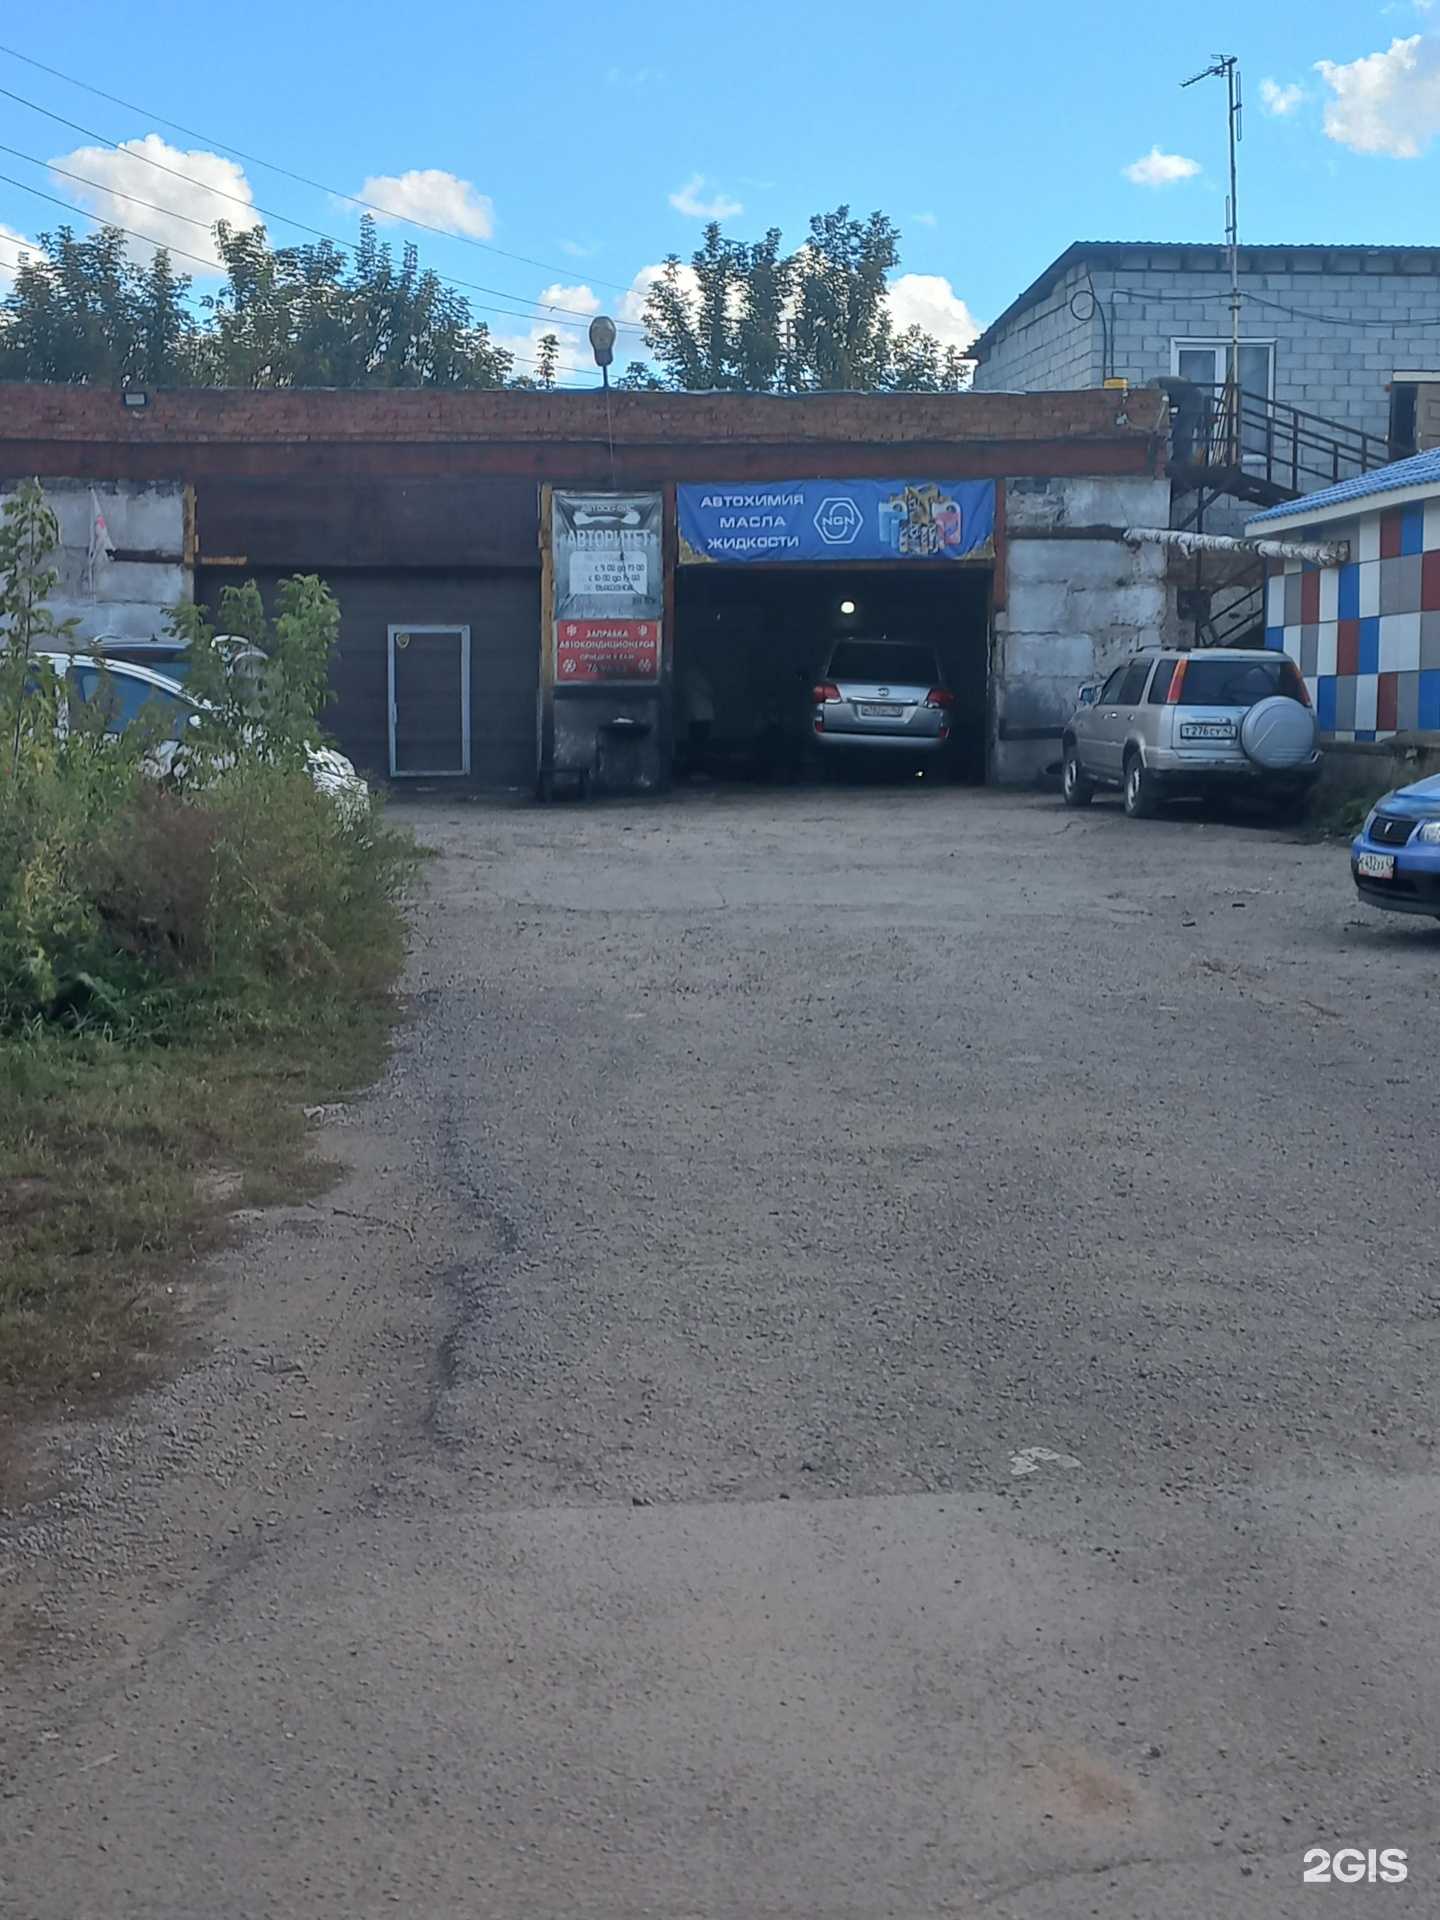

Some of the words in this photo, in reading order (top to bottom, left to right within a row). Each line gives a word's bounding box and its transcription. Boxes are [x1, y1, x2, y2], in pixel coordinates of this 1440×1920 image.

[700, 493, 804, 508] АВТОХИМИЯ
[719, 515, 787, 529] МАСЛА
[821, 516, 856, 527] NGN
[707, 535, 800, 550] ЖИДКОСТИ
[586, 629, 629, 638] ЗАПРАВКА
[559, 640, 656, 649] АВТОКОНДИЦИОНЕРОВ
